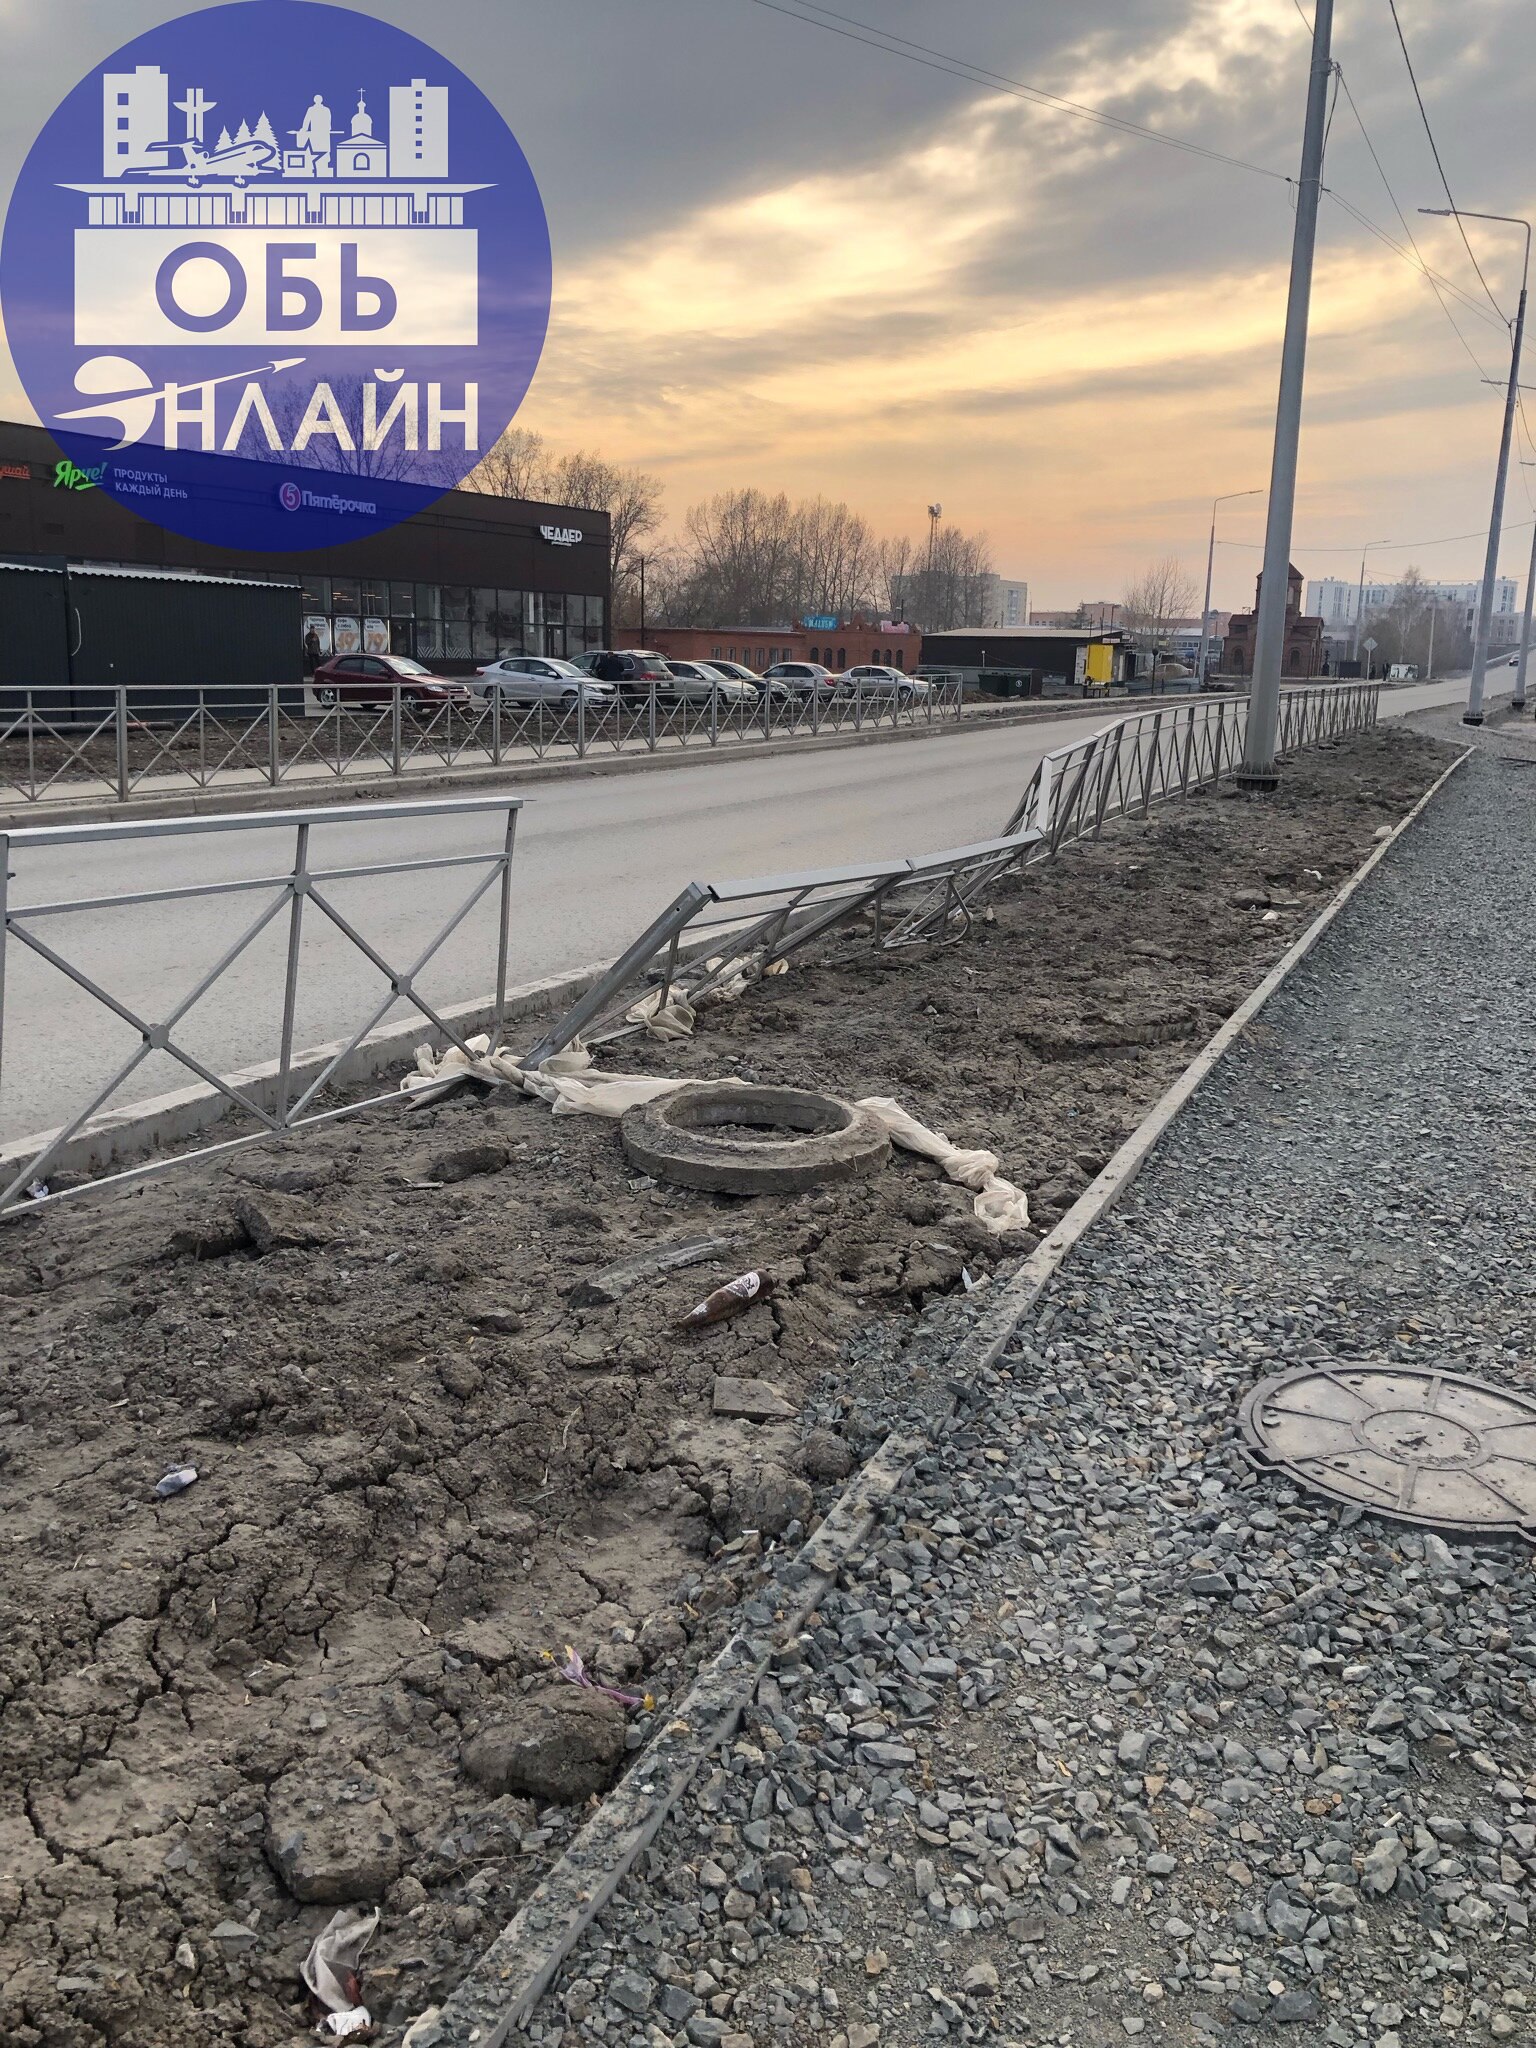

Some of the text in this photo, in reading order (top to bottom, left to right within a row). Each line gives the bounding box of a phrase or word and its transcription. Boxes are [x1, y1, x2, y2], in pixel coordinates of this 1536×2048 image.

[53, 460, 108, 490] Ярче!
[113, 468, 168, 483] ПРОДУКТЫ
[115, 482, 188, 499] КАЖДЫЙ ДЕНЬ
[301, 490, 377, 515] Пятёрочка
